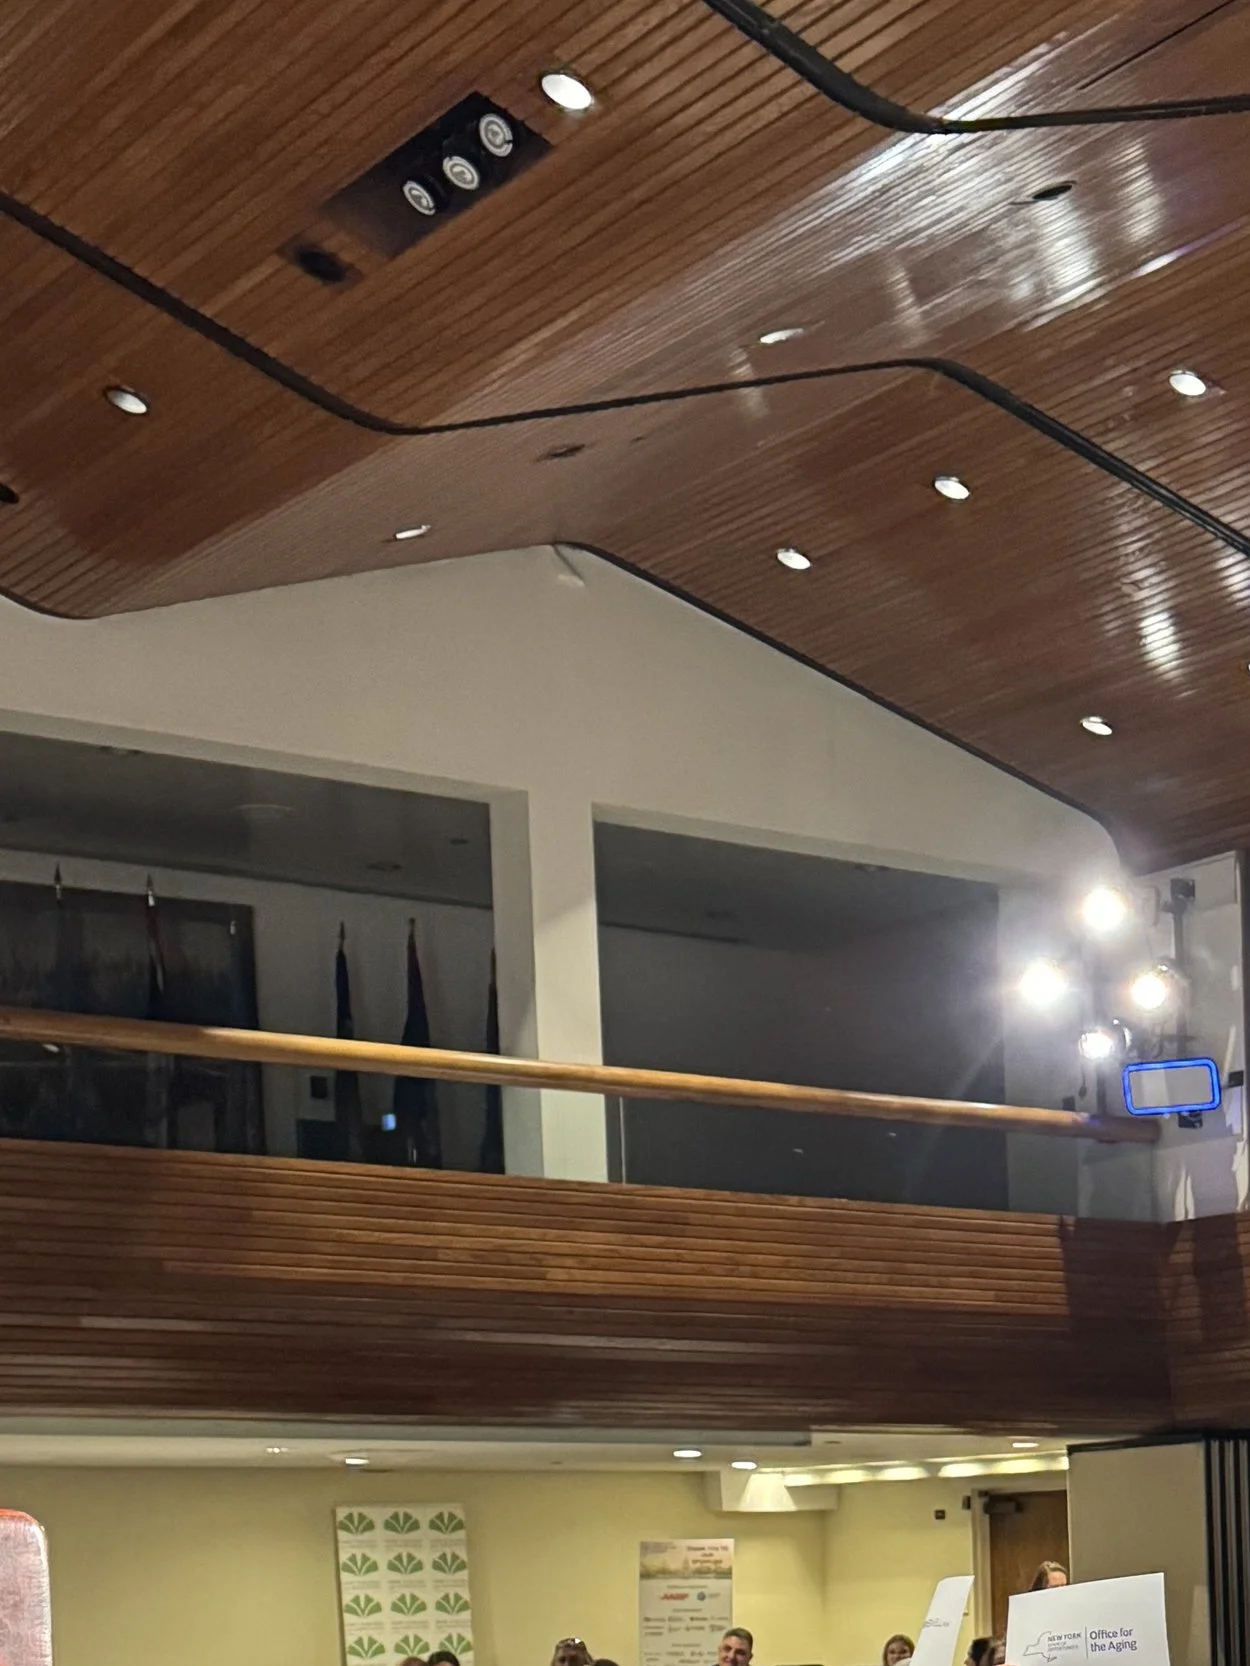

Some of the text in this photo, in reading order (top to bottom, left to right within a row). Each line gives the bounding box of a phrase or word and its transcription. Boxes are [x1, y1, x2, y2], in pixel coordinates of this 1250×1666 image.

[1089, 1627, 1133, 1640] Office for
[1090, 1642, 1106, 1652] the
[1108, 1640, 1137, 1652] Aging
